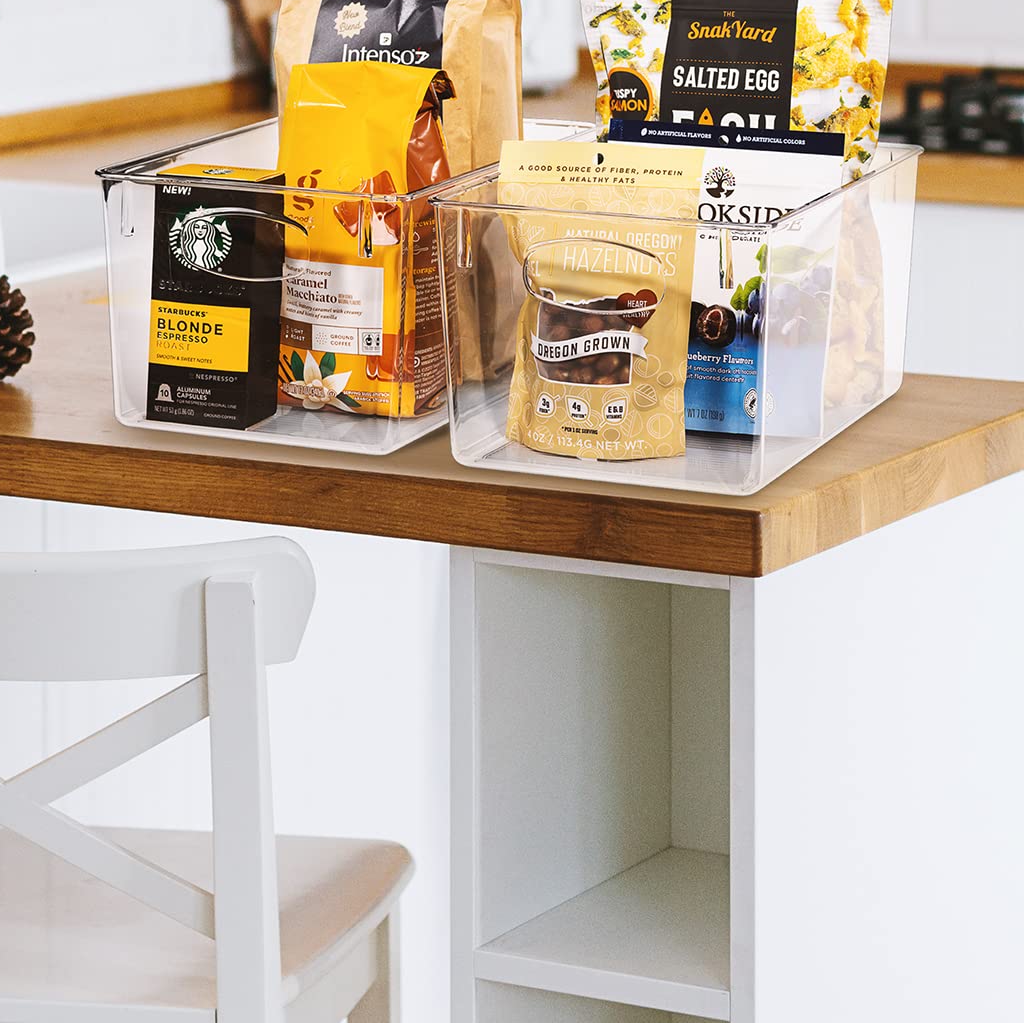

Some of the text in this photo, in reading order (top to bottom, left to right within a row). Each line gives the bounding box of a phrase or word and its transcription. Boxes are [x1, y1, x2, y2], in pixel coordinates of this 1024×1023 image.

[723, 10, 735, 18] THE
[672, 65, 780, 92] SALTED EGG
[657, 130, 687, 138] ARTIFICIAL
[687, 131, 712, 139] FLAVORS
[752, 136, 783, 144] ARTIFICIAL
[556, 165, 592, 173] SOURCE
[609, 167, 640, 175] FIBER,
[162, 185, 192, 196] NEW!
[562, 246, 677, 277] HAZELNUTS
[286, 285, 338, 304] Macchiato
[627, 299, 648, 308] HEART
[158, 306, 208, 318] STARBUCKS
[157, 318, 223, 336] BLONDE
[156, 331, 209, 344] ESPRESSO
[156, 340, 191, 352] ROAST
[537, 336, 631, 359] OREGON GROWN
[156, 353, 176, 361] SMOOTH
[694, 373, 721, 382] flavored
[160, 389, 169, 398] 10
[176, 386, 212, 396] ALUMINUM
[176, 392, 208, 401] CAPSULES
[541, 397, 550, 409] 3g
[572, 401, 582, 412] 4g
[533, 432, 546, 444] OZ
[557, 436, 593, 449] 113.4G
[595, 440, 621, 451] NET
[624, 439, 648, 450] WT.
